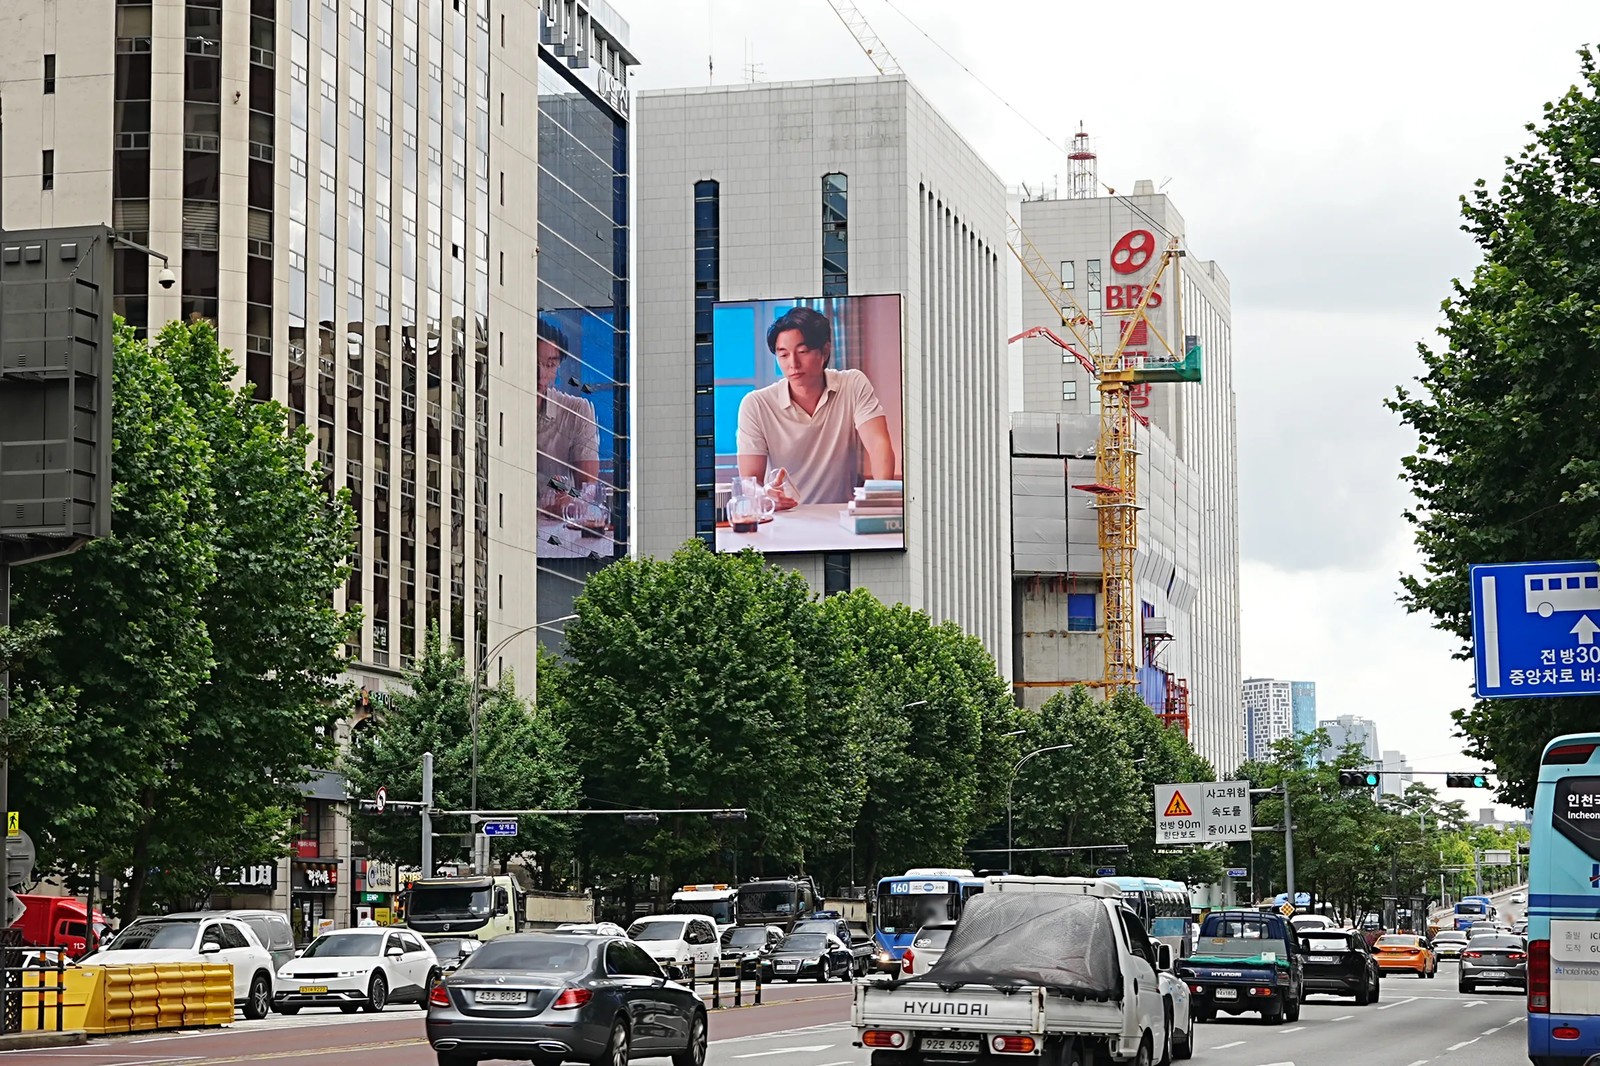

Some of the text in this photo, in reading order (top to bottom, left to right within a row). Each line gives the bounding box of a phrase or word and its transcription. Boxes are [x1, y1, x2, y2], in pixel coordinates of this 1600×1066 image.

[1106, 284, 1163, 310] BBS
[1509, 668, 1575, 686] 중앙차로
[1206, 787, 1246, 798] 사고위험
[1212, 806, 1241, 817] 속도를
[1567, 811, 1600, 819] Incheon
[1160, 820, 1201, 830] 전방 90m
[1208, 824, 1248, 836] 줄이시오
[1164, 830, 1196, 840] 횡단보도
[892, 883, 908, 893] 160
[1590, 932, 1600, 940] IC
[1565, 944, 1581, 952] 도착
[1562, 967, 1599, 976] hotel nikko
[904, 1001, 988, 1016] HYUNDAI
[949, 1040, 975, 1051] 4369
